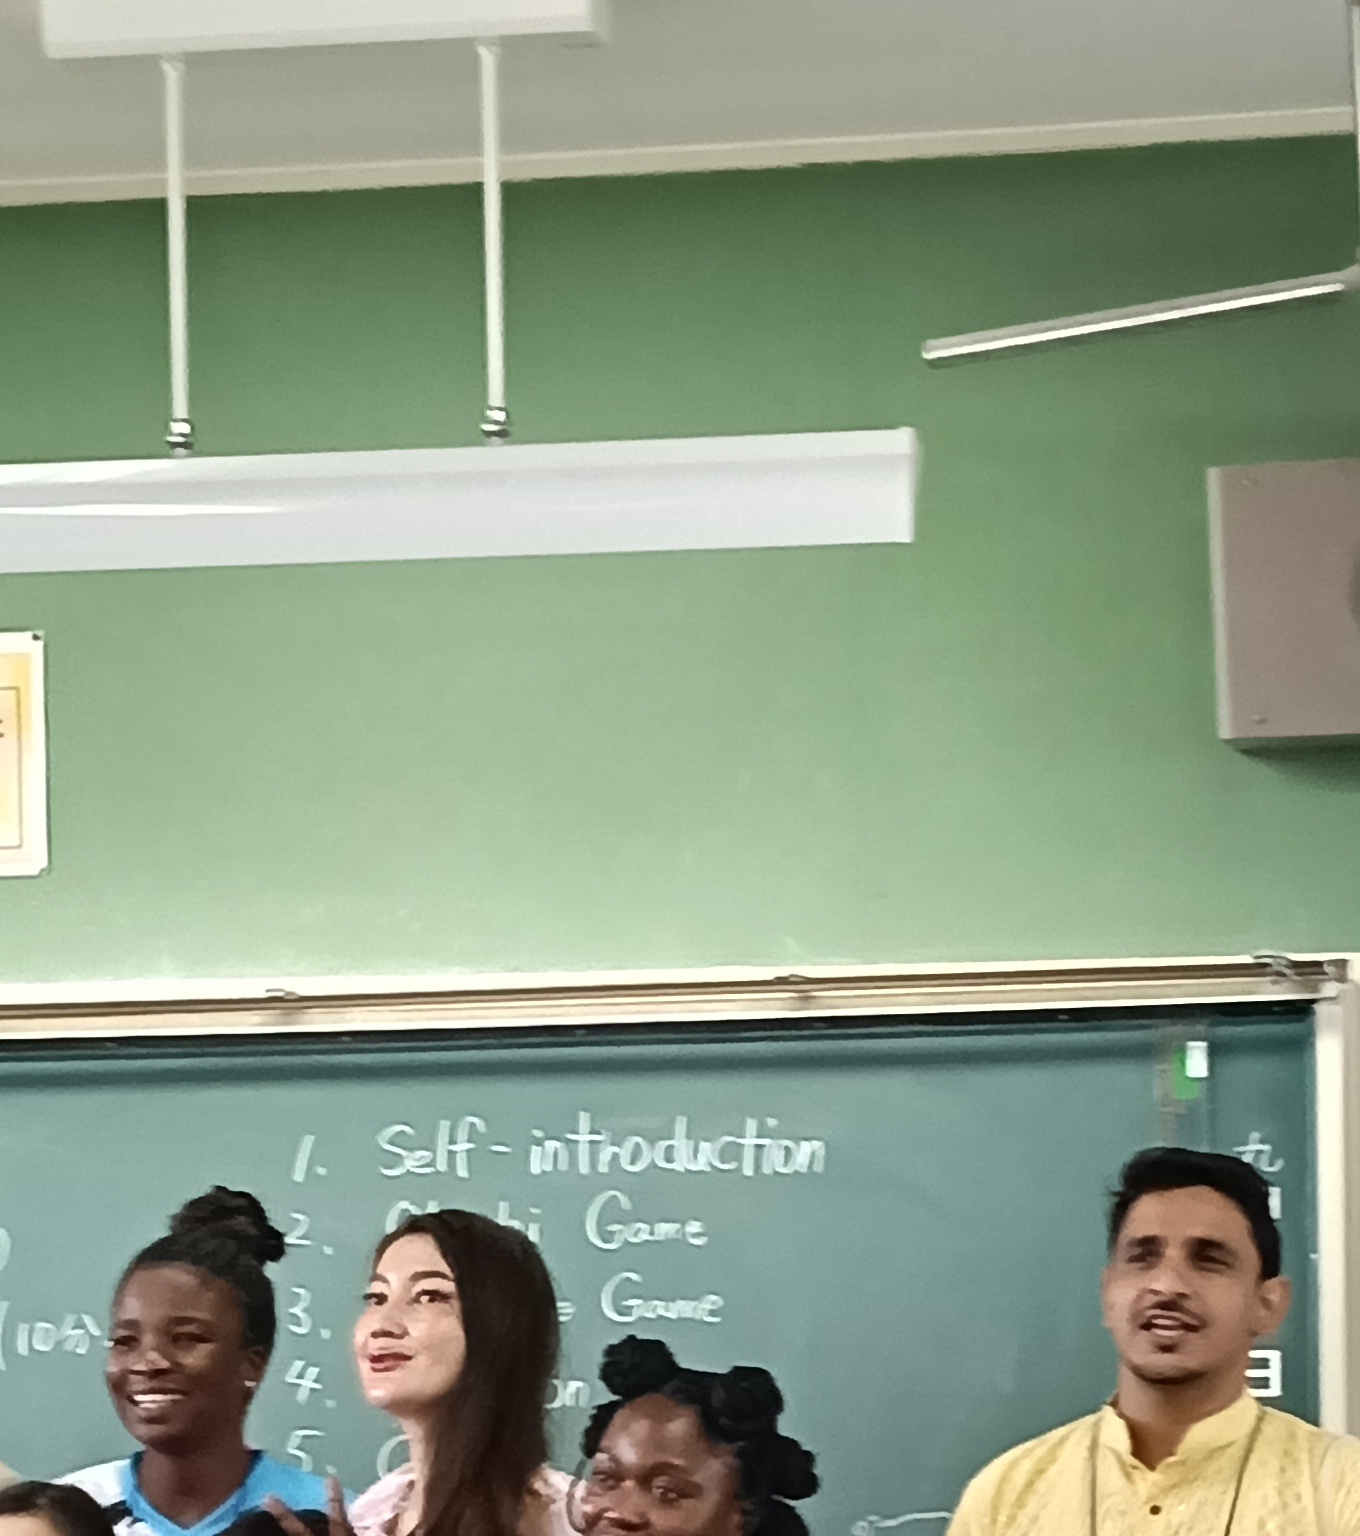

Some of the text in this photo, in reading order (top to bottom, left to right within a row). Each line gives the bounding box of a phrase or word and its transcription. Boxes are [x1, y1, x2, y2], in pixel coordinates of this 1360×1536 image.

[291, 1110, 827, 1183] 1. Self-introduction
[584, 1190, 708, 1250] Game
[599, 1271, 725, 1324] Game
